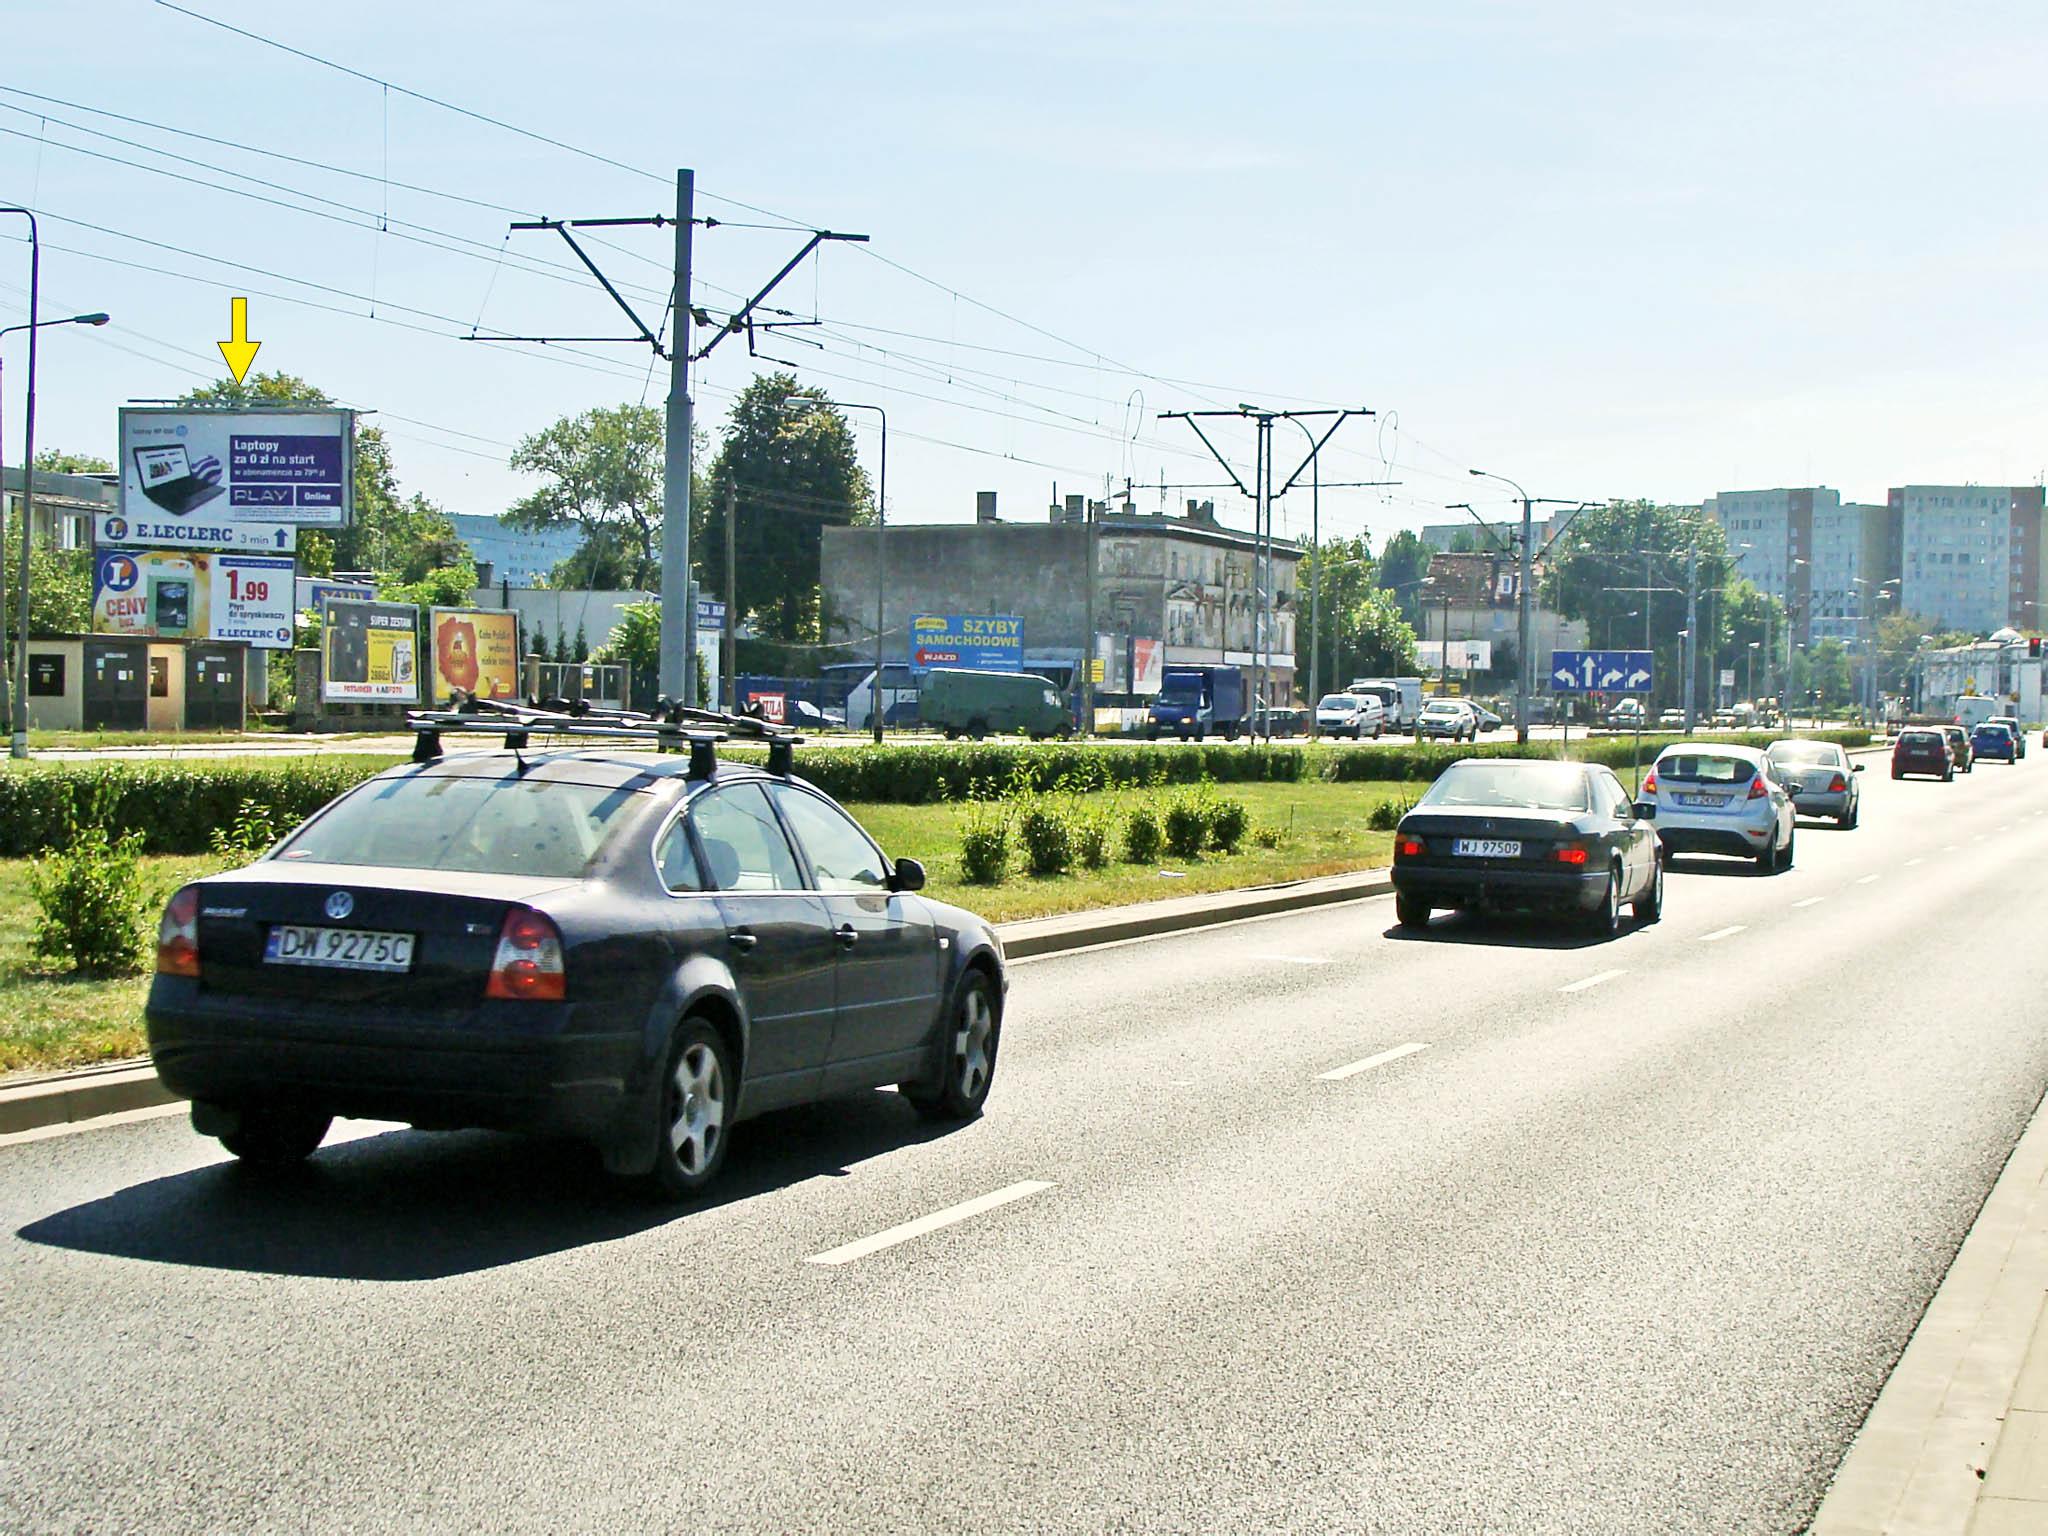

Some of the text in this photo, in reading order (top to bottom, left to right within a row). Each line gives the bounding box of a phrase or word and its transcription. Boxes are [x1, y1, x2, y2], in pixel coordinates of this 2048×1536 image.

[234, 440, 279, 452] Laptopy
[234, 455, 247, 464] za
[249, 454, 257, 464] 0
[272, 455, 286, 464] na
[289, 454, 315, 465] start
[234, 489, 332, 502] PLAY Online
[136, 523, 233, 542] E.LECLERC
[240, 533, 247, 544] 3
[250, 533, 269, 545] min
[226, 569, 269, 602] 1.99
[106, 597, 147, 617] CENY
[217, 628, 273, 639] E.LECLERC
[963, 619, 1019, 635] SZYBY
[916, 634, 1020, 648] SAMOCHODOWE
[923, 653, 957, 662] WJAZD
[1461, 840, 1519, 854] WJ 97509
[326, 931, 409, 963] 9275C
